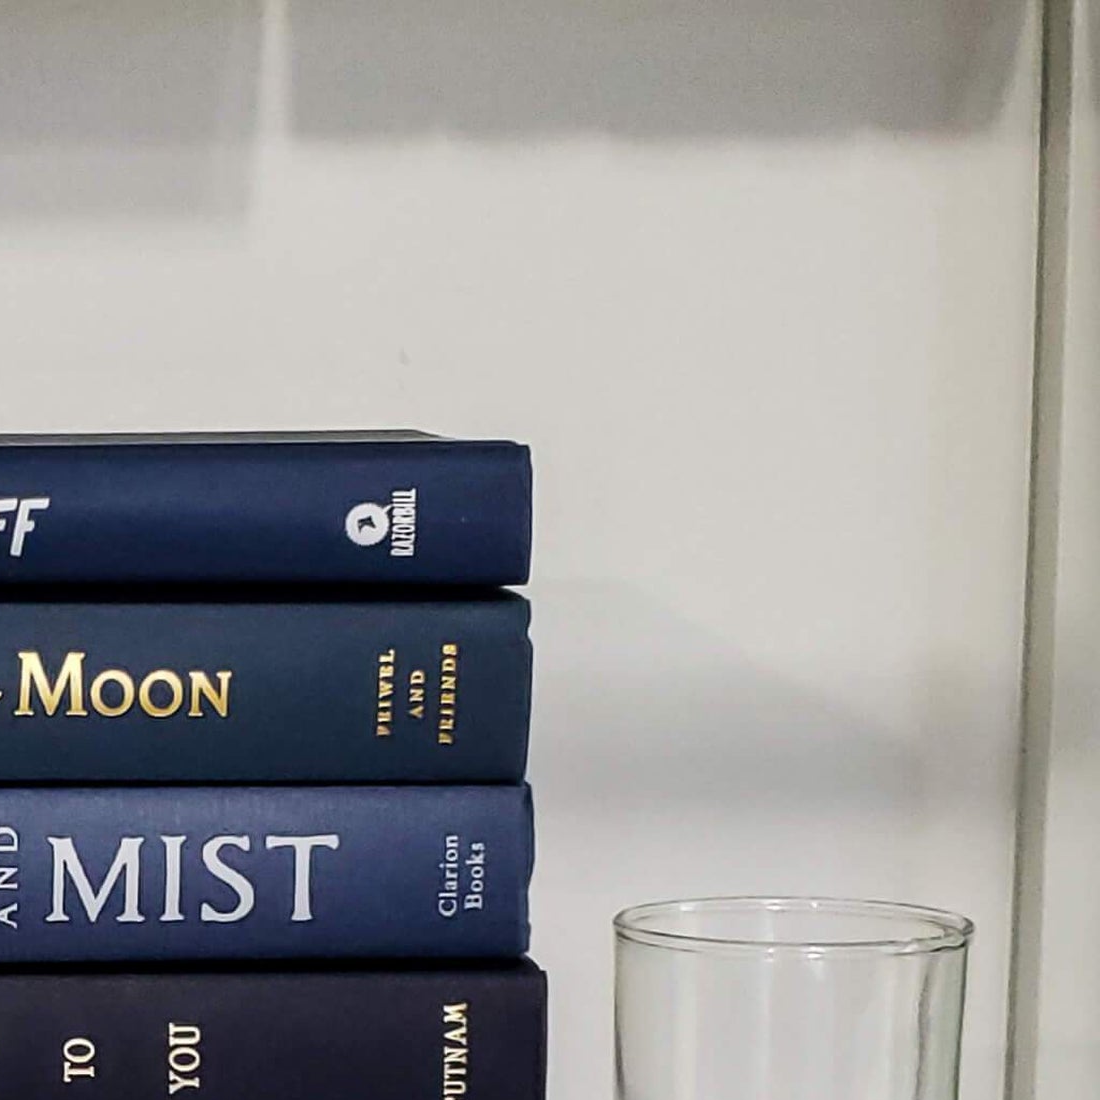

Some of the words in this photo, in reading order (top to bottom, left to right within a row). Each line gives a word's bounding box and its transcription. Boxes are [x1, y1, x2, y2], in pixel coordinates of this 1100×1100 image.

[390, 488, 416, 557] RAZORBILL
[14, 651, 233, 717] MOON
[409, 669, 425, 718] AND
[438, 644, 457, 744] FRIENDS
[46, 834, 340, 925] MIST
[438, 835, 459, 917] Clarion
[464, 842, 485, 909] Books
[63, 1037, 96, 1083] TO
[168, 1022, 201, 1095] YOU
